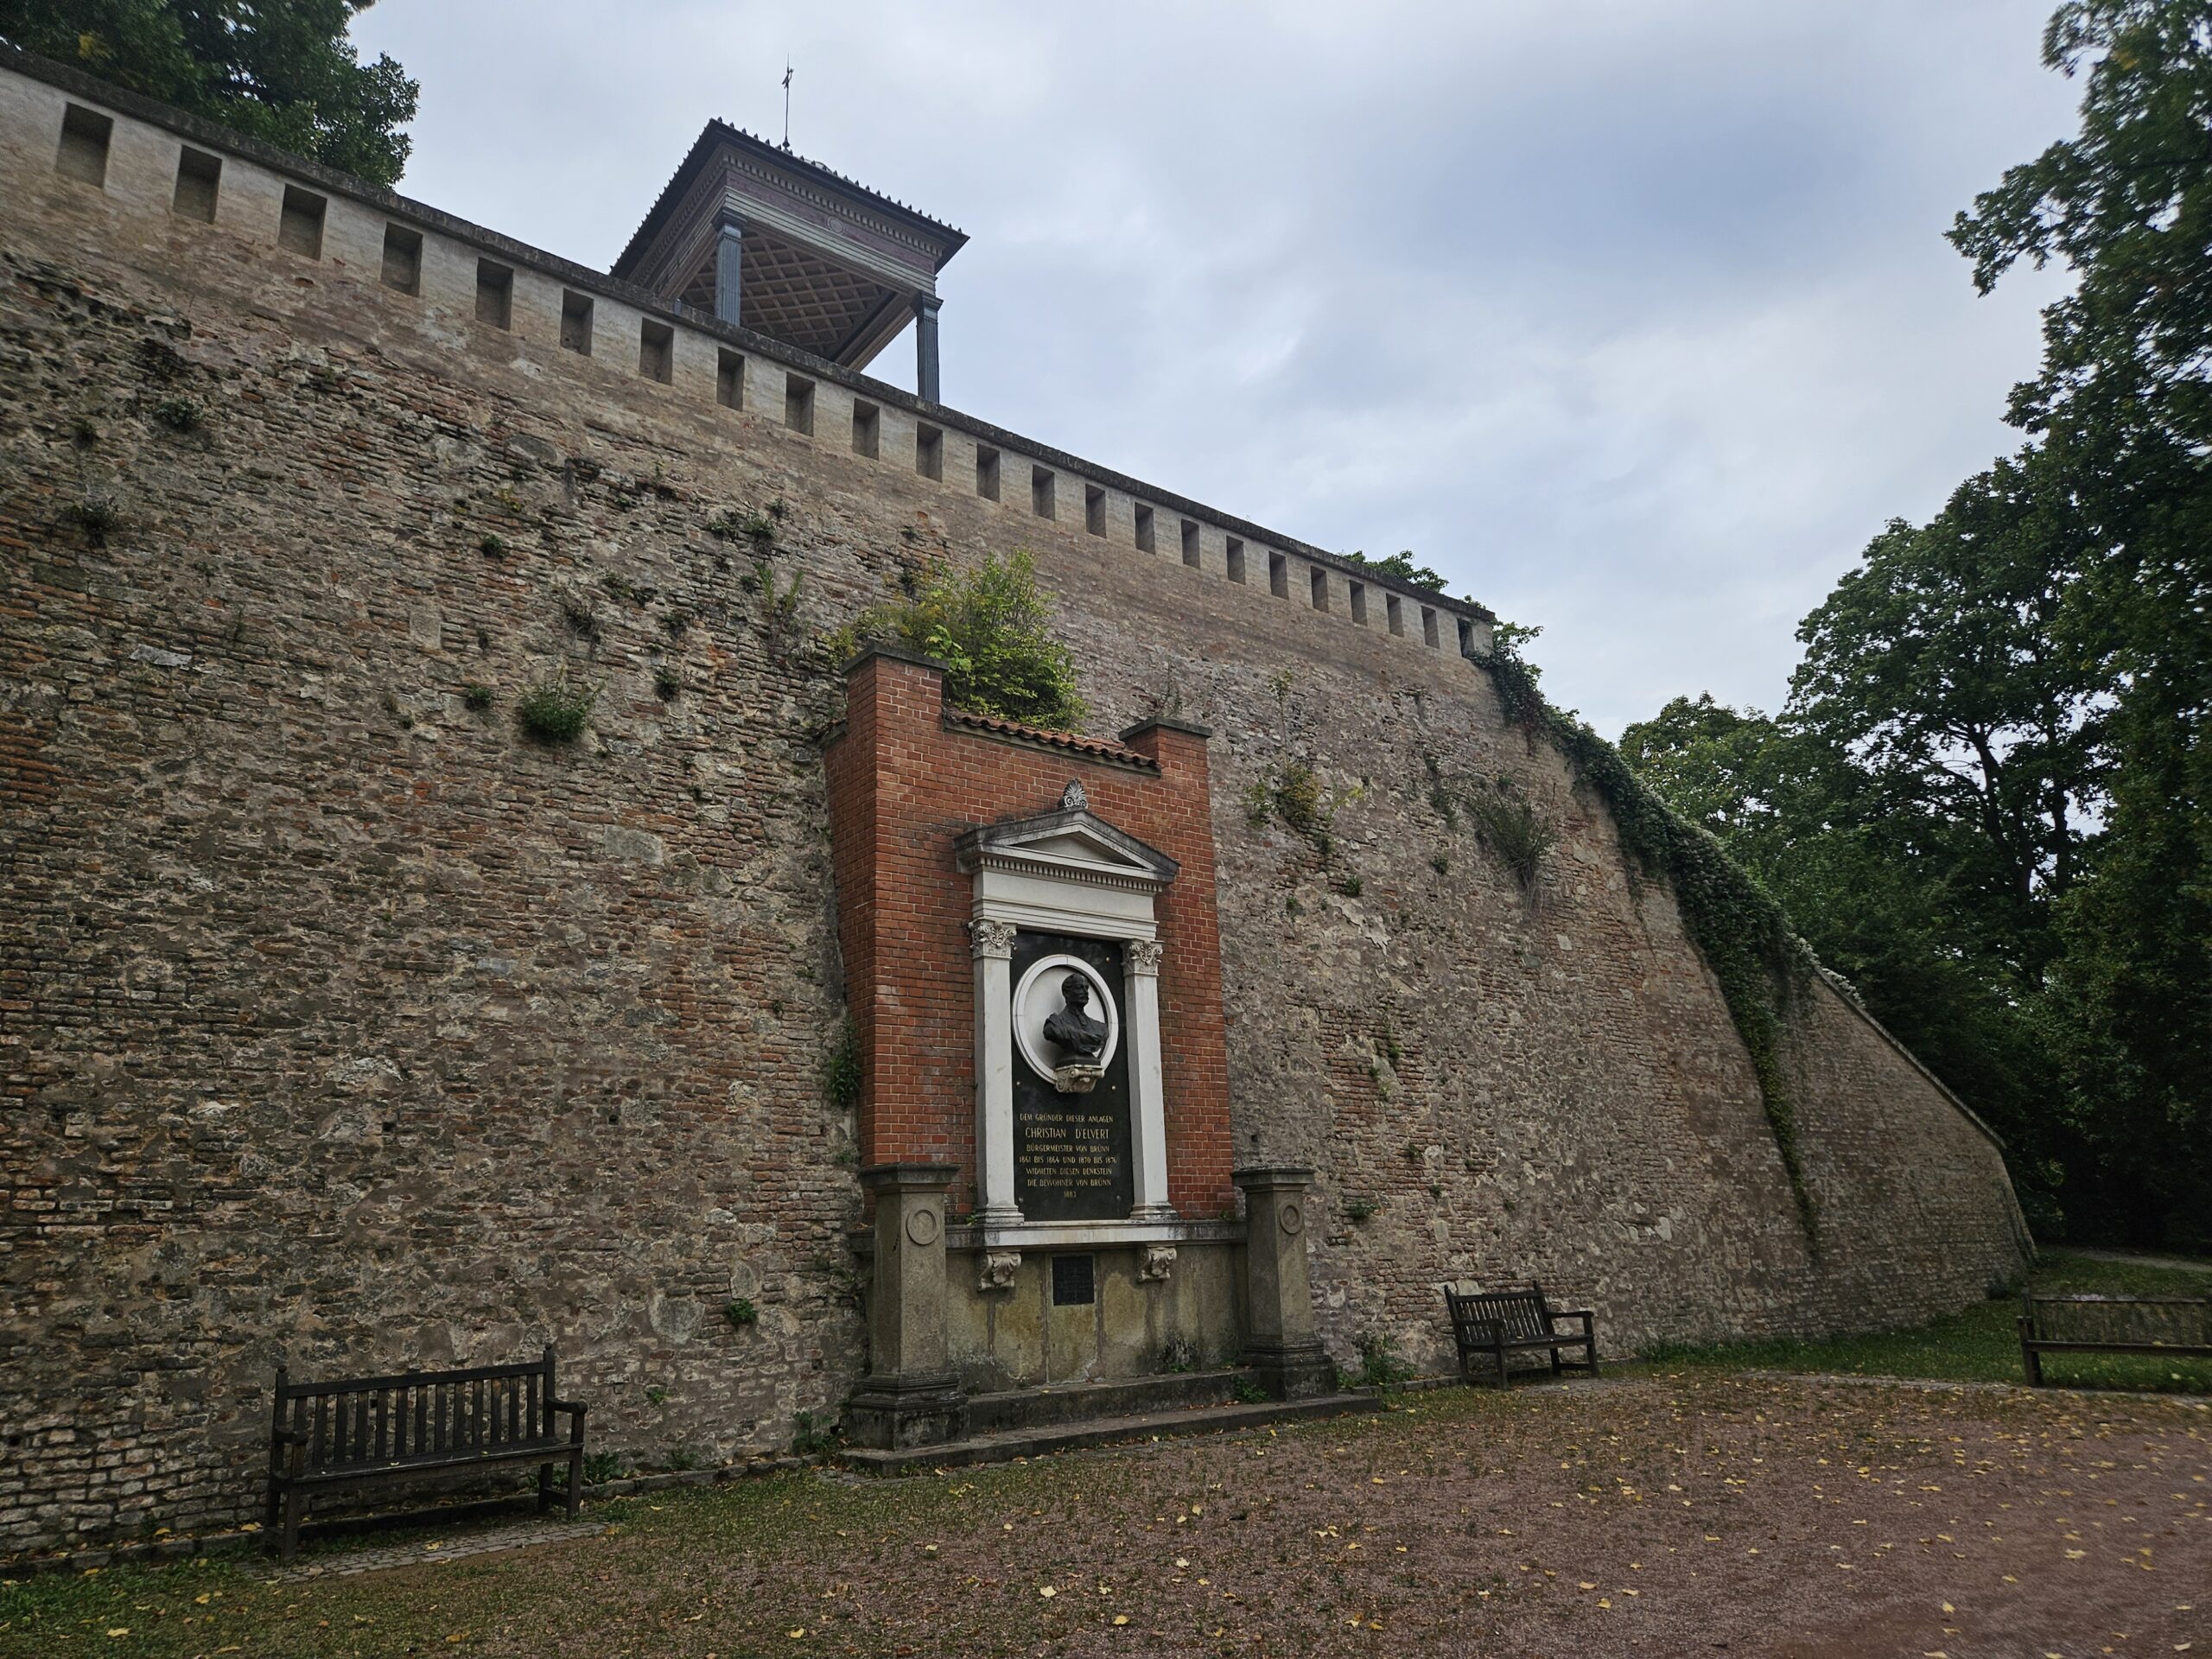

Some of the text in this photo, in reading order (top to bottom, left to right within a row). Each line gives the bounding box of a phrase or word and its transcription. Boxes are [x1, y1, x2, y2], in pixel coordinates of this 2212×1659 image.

[1026, 1128, 1109, 1139] CHRISTIAN D'ELVERT
[1090, 1144, 1109, 1153] BRÜNN
[1090, 1178, 1111, 1186] BRÜNN
